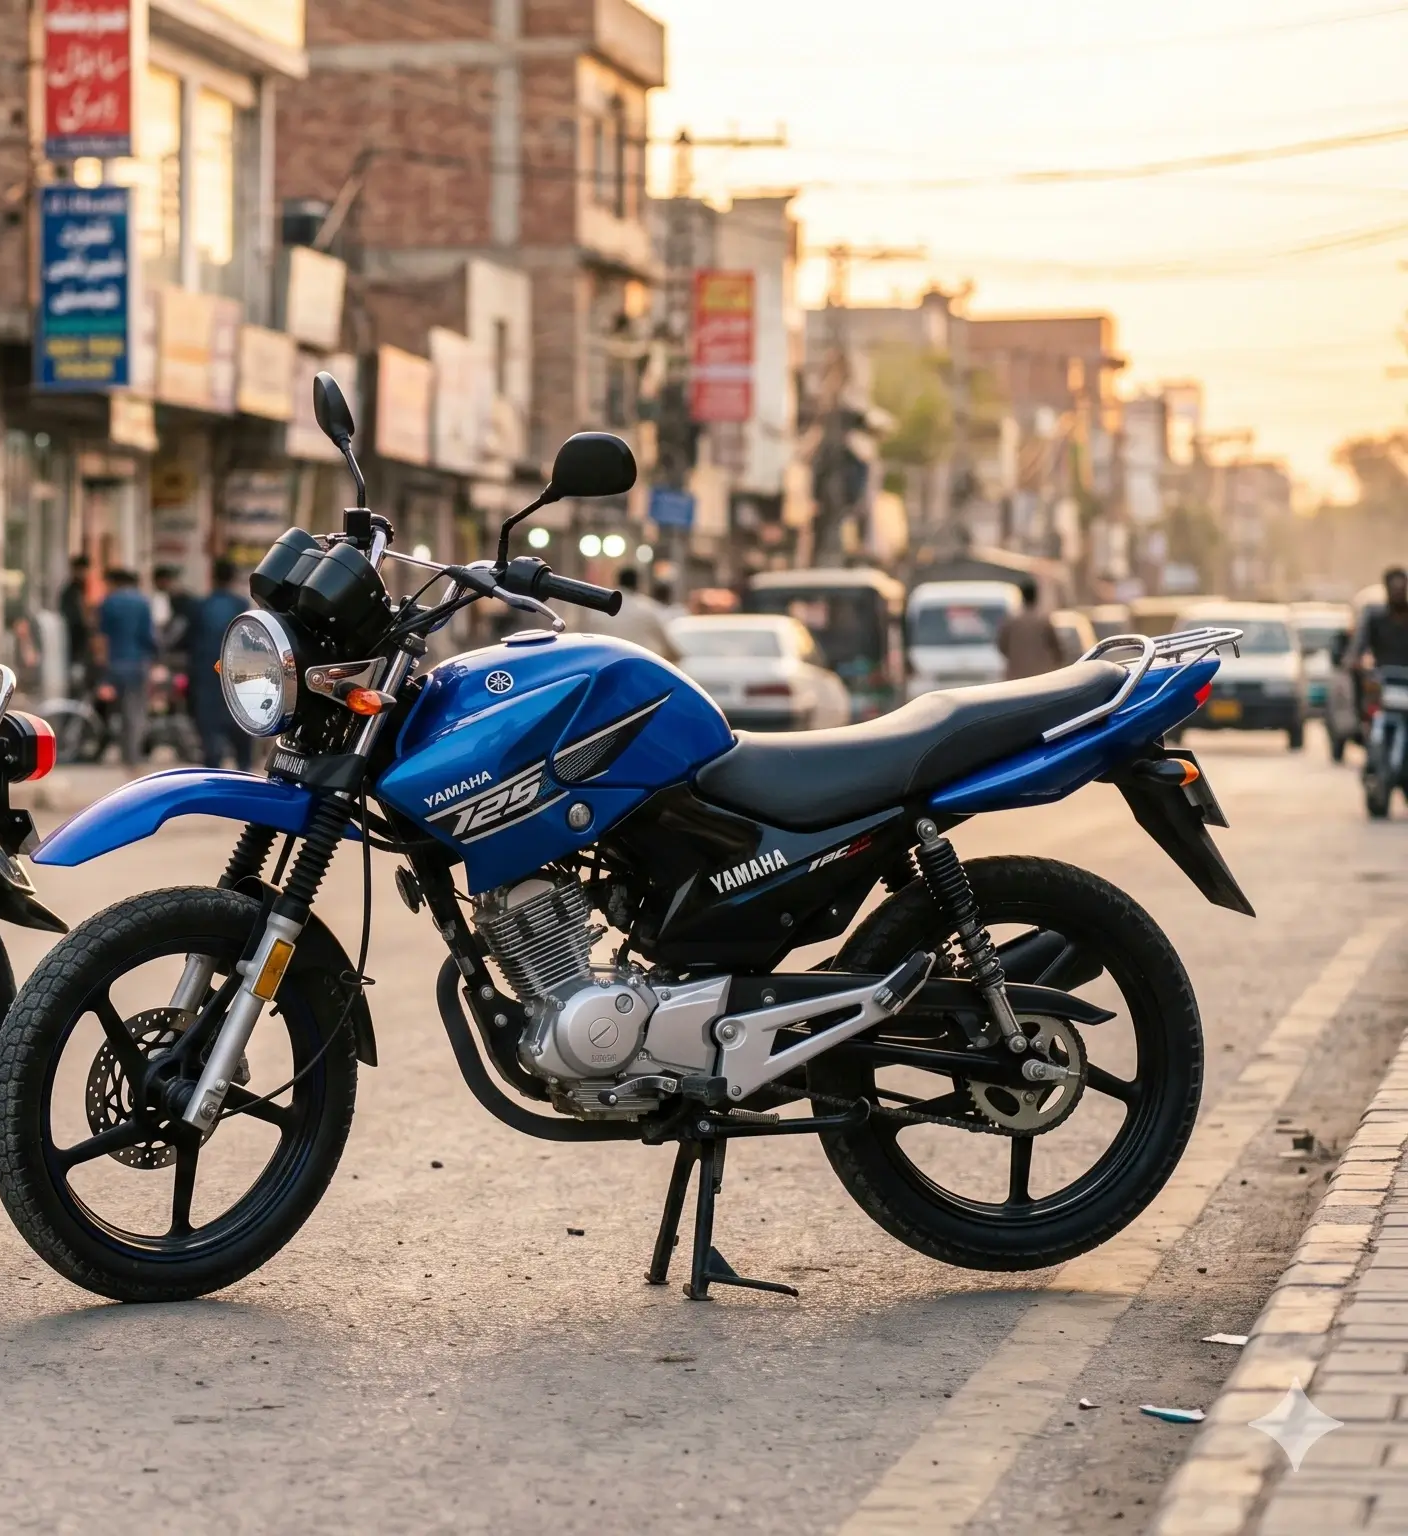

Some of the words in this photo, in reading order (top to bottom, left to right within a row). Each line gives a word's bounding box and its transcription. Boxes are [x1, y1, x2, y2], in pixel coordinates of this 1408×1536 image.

[423, 770, 493, 809] YAMAHA
[451, 770, 543, 837] 125
[709, 848, 789, 894] YAMAHA
